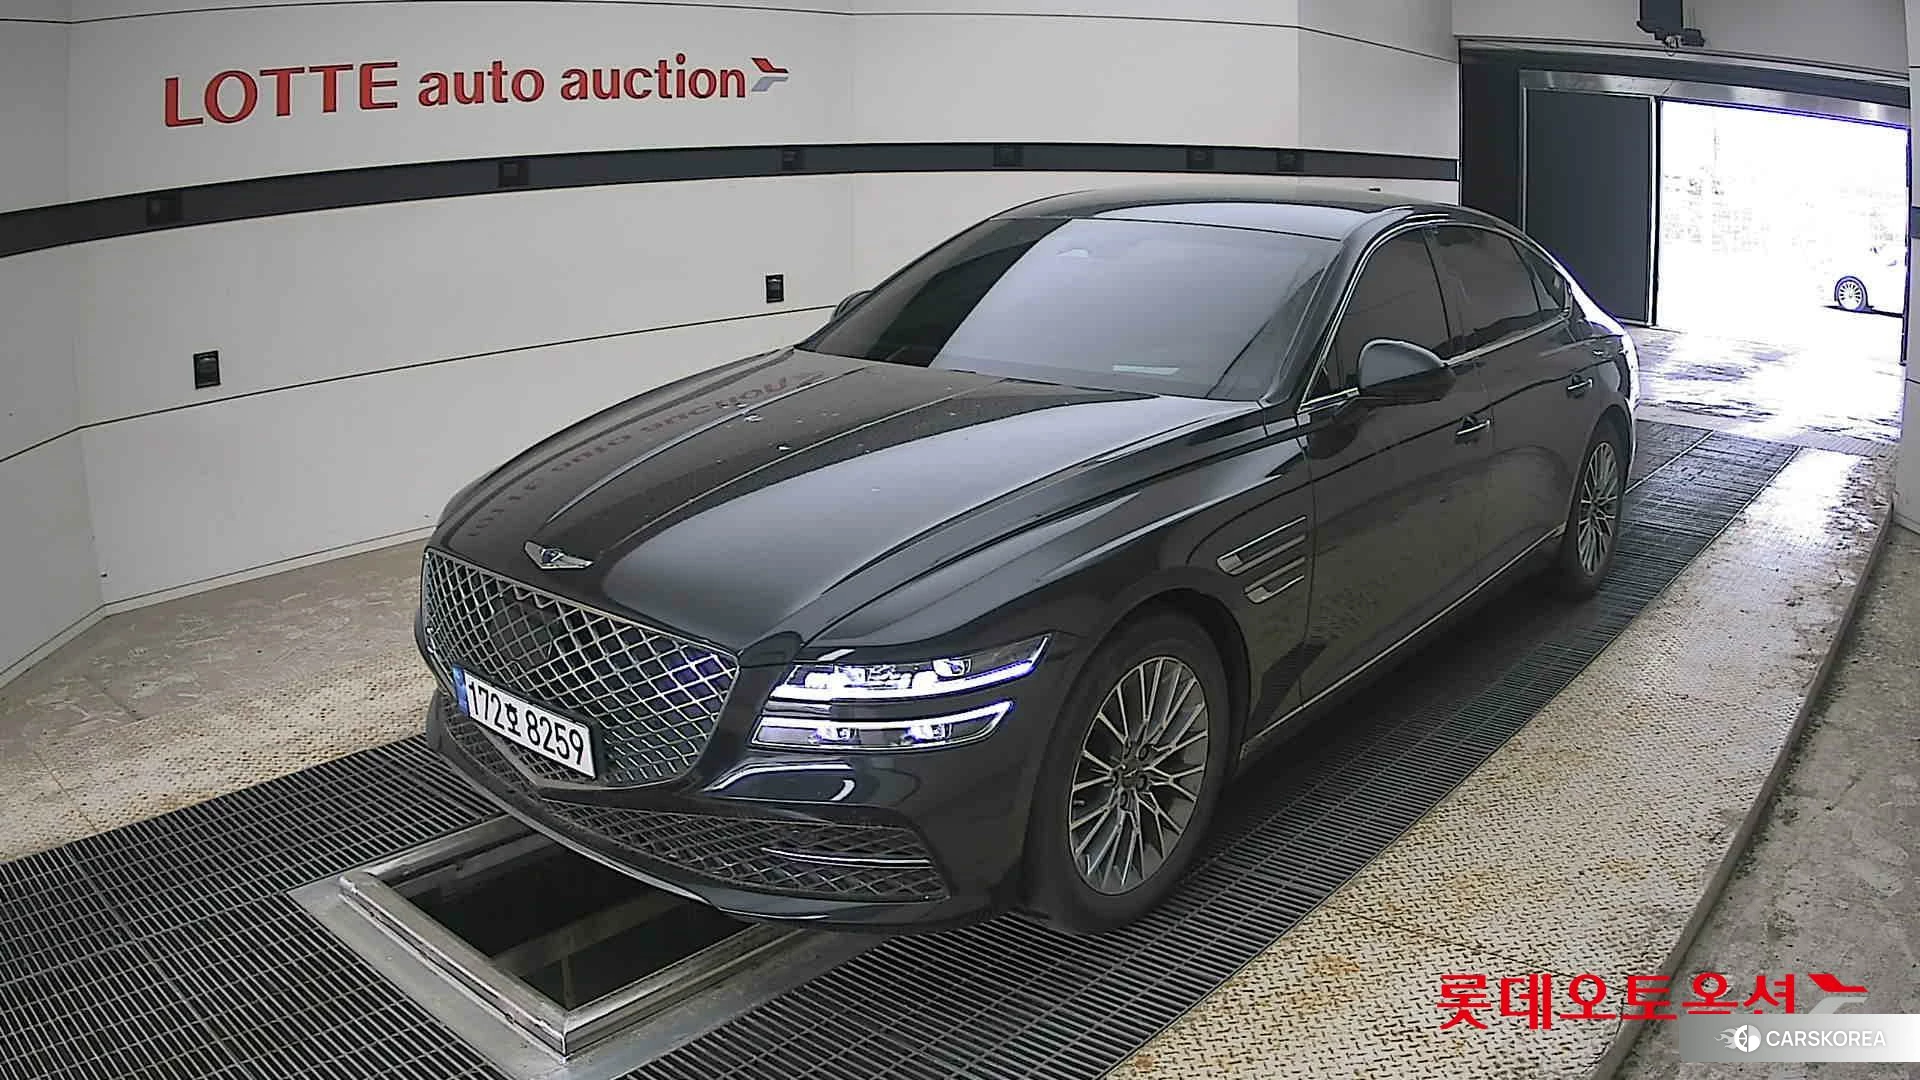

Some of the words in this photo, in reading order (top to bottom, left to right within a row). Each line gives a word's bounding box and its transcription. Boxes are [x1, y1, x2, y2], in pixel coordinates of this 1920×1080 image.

[164, 61, 399, 128] LOTTE
[417, 60, 545, 107] auto
[561, 53, 747, 101] auction
[468, 681, 522, 737] 172호
[525, 709, 584, 765] 8259
